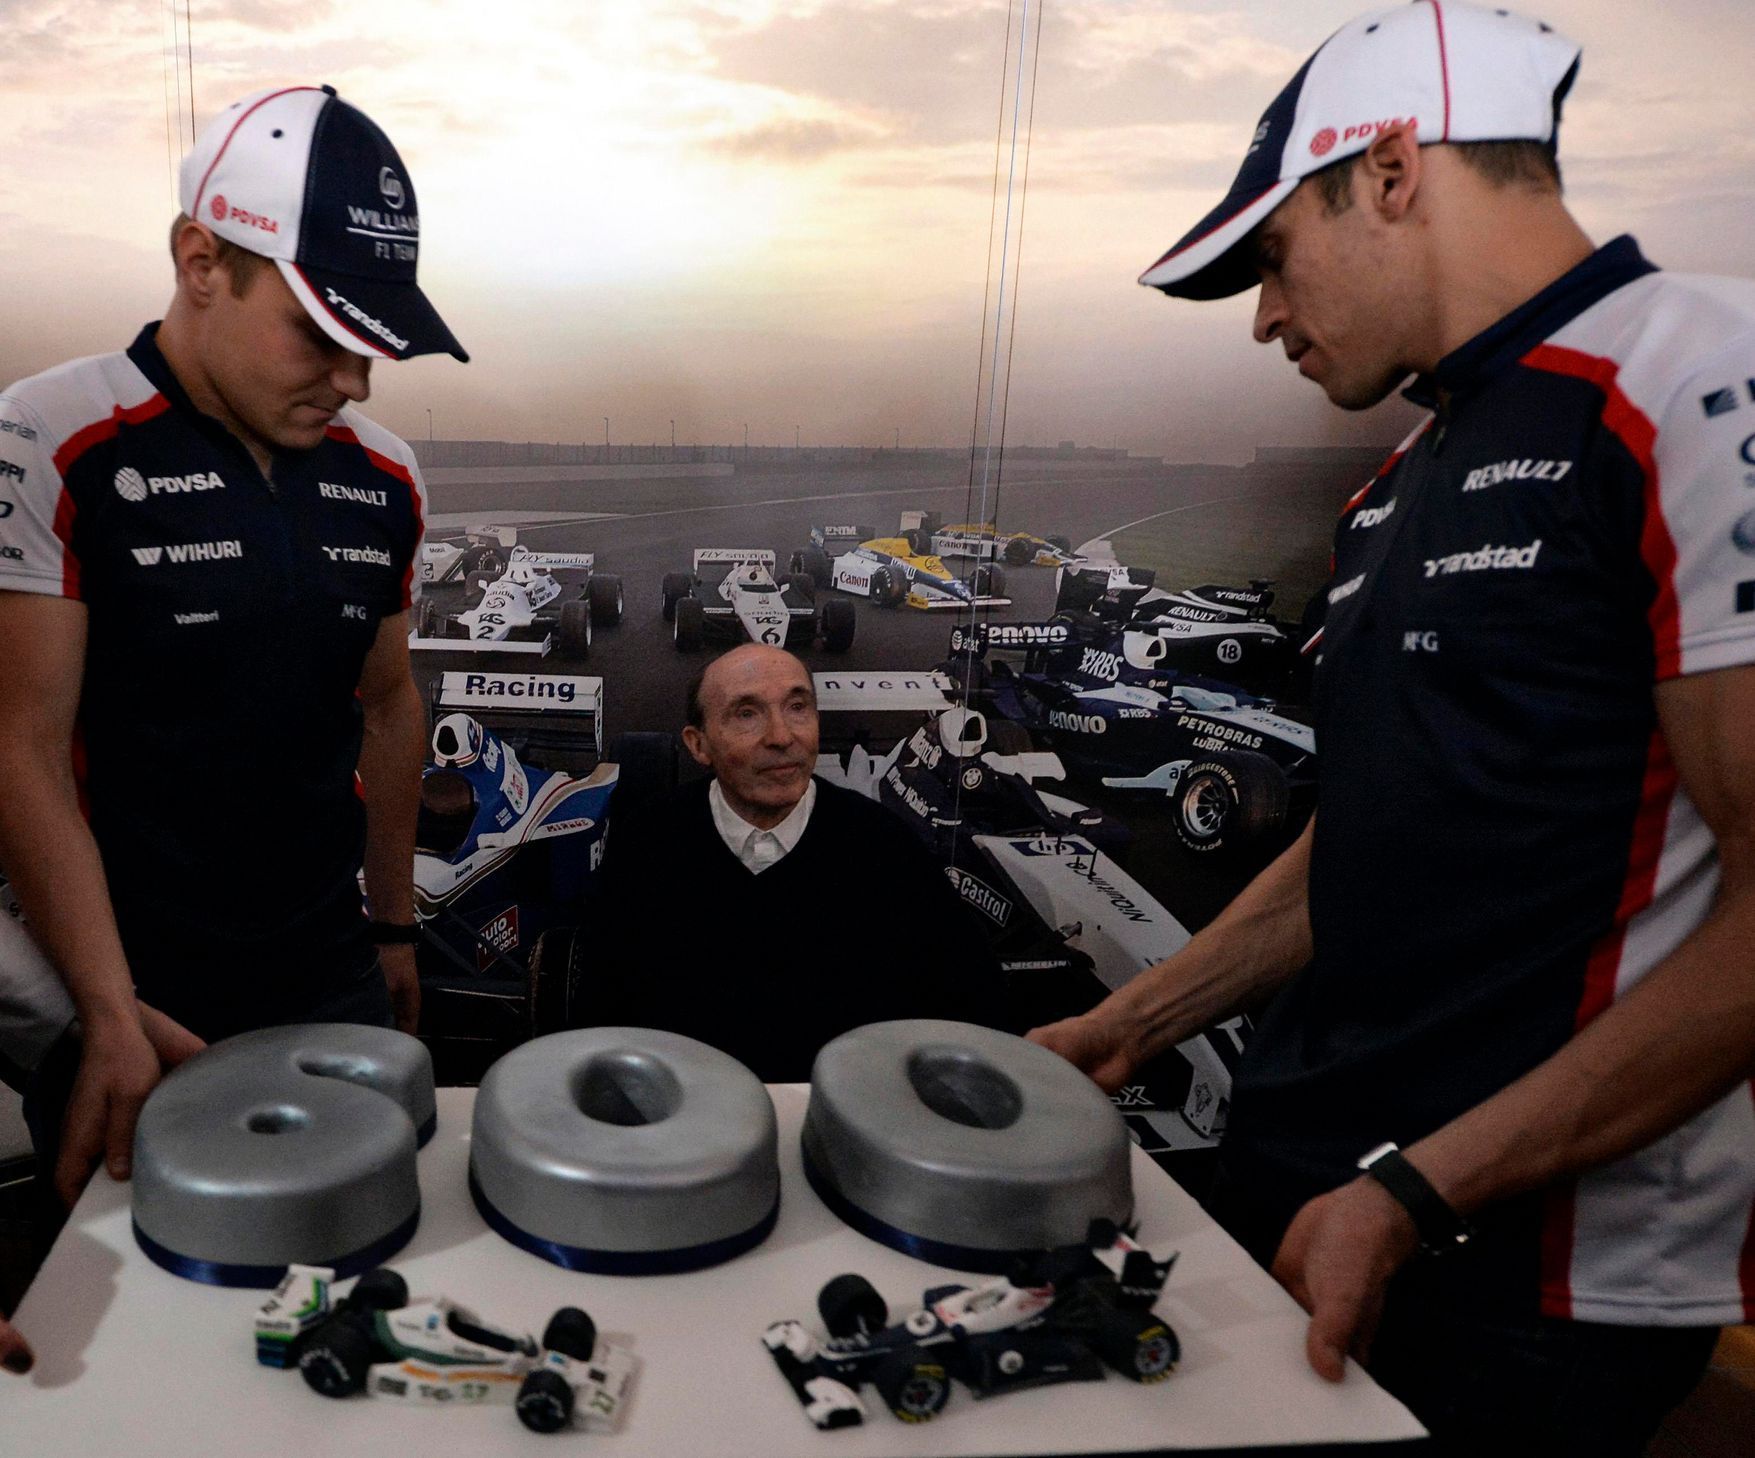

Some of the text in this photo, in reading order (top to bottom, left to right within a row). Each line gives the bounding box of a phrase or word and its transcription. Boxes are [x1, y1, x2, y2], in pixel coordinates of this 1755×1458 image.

[230, 206, 280, 234] PDVSA
[148, 471, 226, 494] PDVSA
[1462, 459, 1573, 493] RENAULT
[318, 481, 387, 507] RENAULT
[164, 540, 243, 564] WIHURI
[343, 546, 391, 566] randstad
[1437, 538, 1543, 574] randstad
[840, 571, 868, 588] Canon
[1167, 606, 1216, 622] RENAULT
[477, 626, 494, 640] 2
[761, 626, 781, 644] 6
[1220, 643, 1238, 660] 18
[465, 674, 576, 702] Racing
[1177, 714, 1264, 750] PETROBRAS
[1192, 736, 1238, 752] LUBRA
[455, 862, 473, 881] Racing
[960, 877, 1007, 921] Castrol
